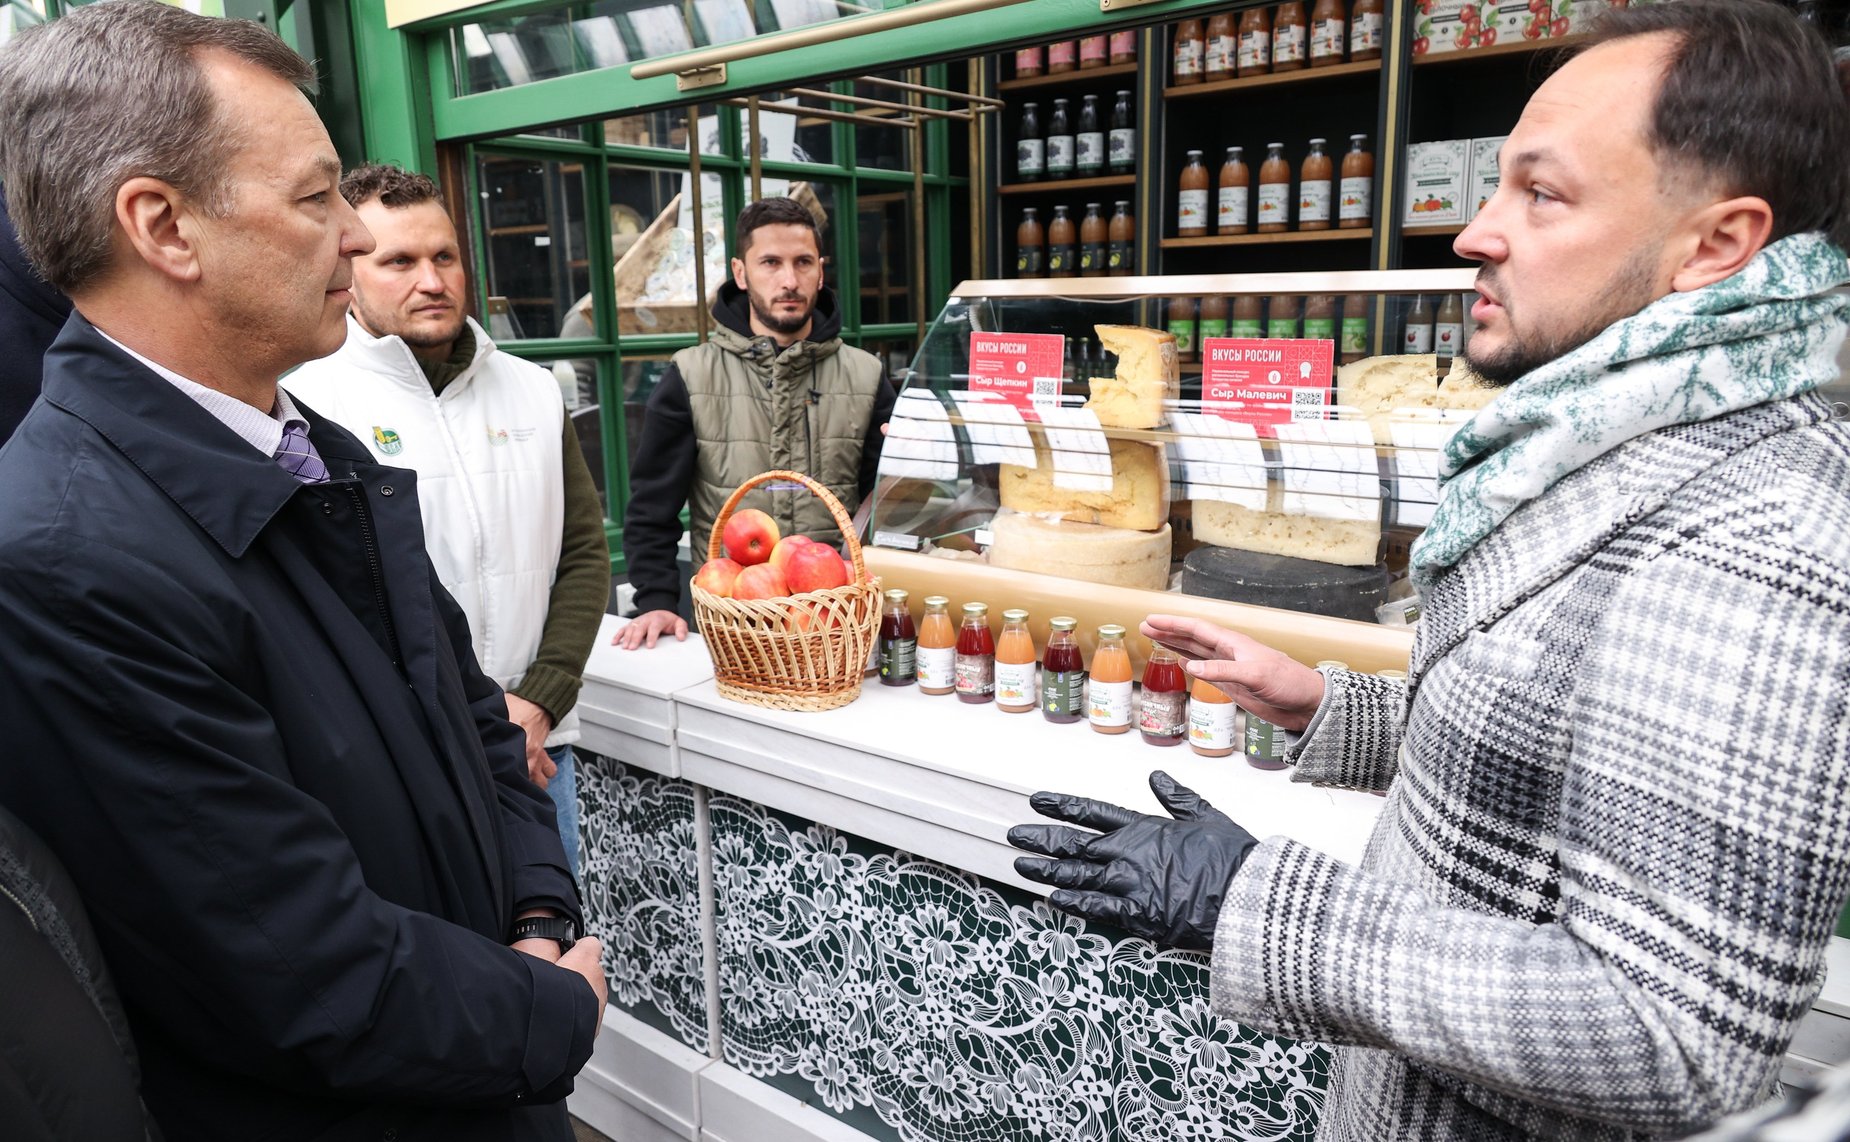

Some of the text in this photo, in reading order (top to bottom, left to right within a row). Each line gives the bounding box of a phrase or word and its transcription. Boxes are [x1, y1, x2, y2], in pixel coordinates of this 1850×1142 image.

[976, 341, 1027, 354] ВКУСЫ РОССИИ
[1212, 348, 1282, 362] ВКУСЫ РОССИИ
[975, 376, 993, 386] Сыр
[1210, 388, 1287, 400] Сыр Малевич
